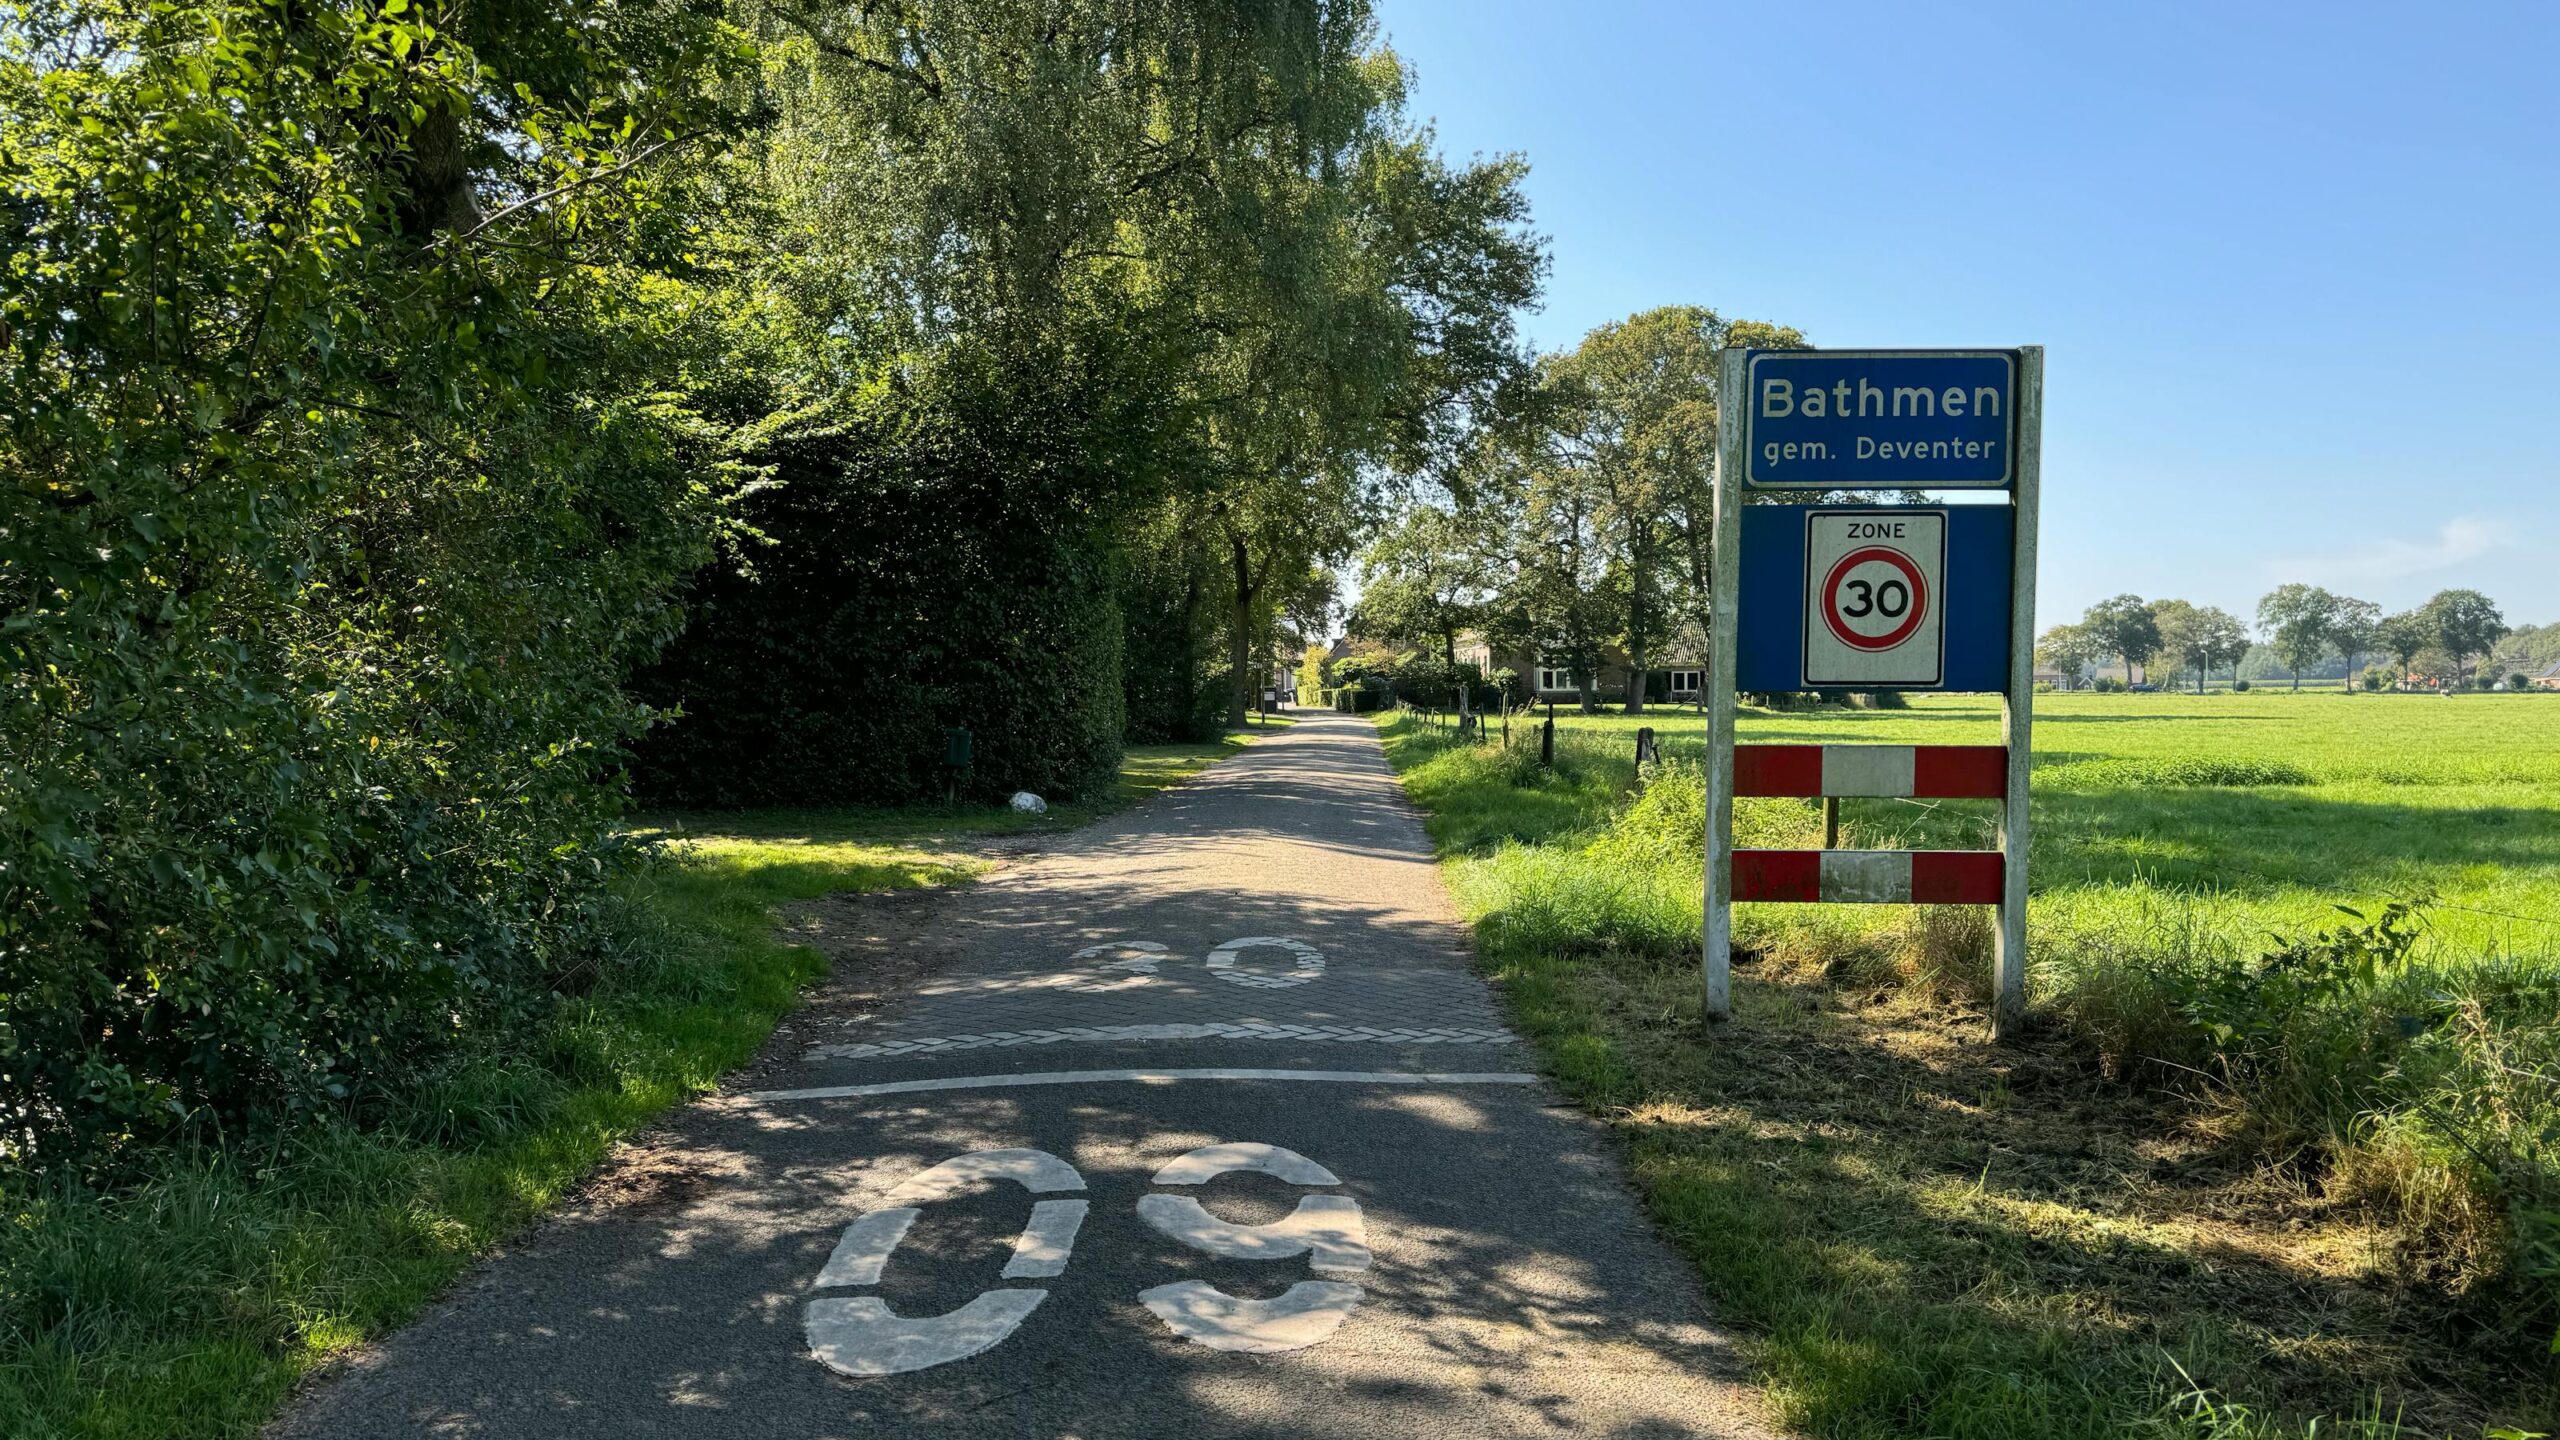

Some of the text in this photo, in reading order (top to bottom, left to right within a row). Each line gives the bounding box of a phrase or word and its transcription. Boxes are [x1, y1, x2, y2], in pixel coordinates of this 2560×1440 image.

[1762, 377, 1999, 417] Bathmen
[1764, 437, 1995, 466] gem. Deventer
[1847, 523, 1906, 538] ZONE
[1842, 580, 1909, 618] 30
[1052, 936, 1327, 993] 30
